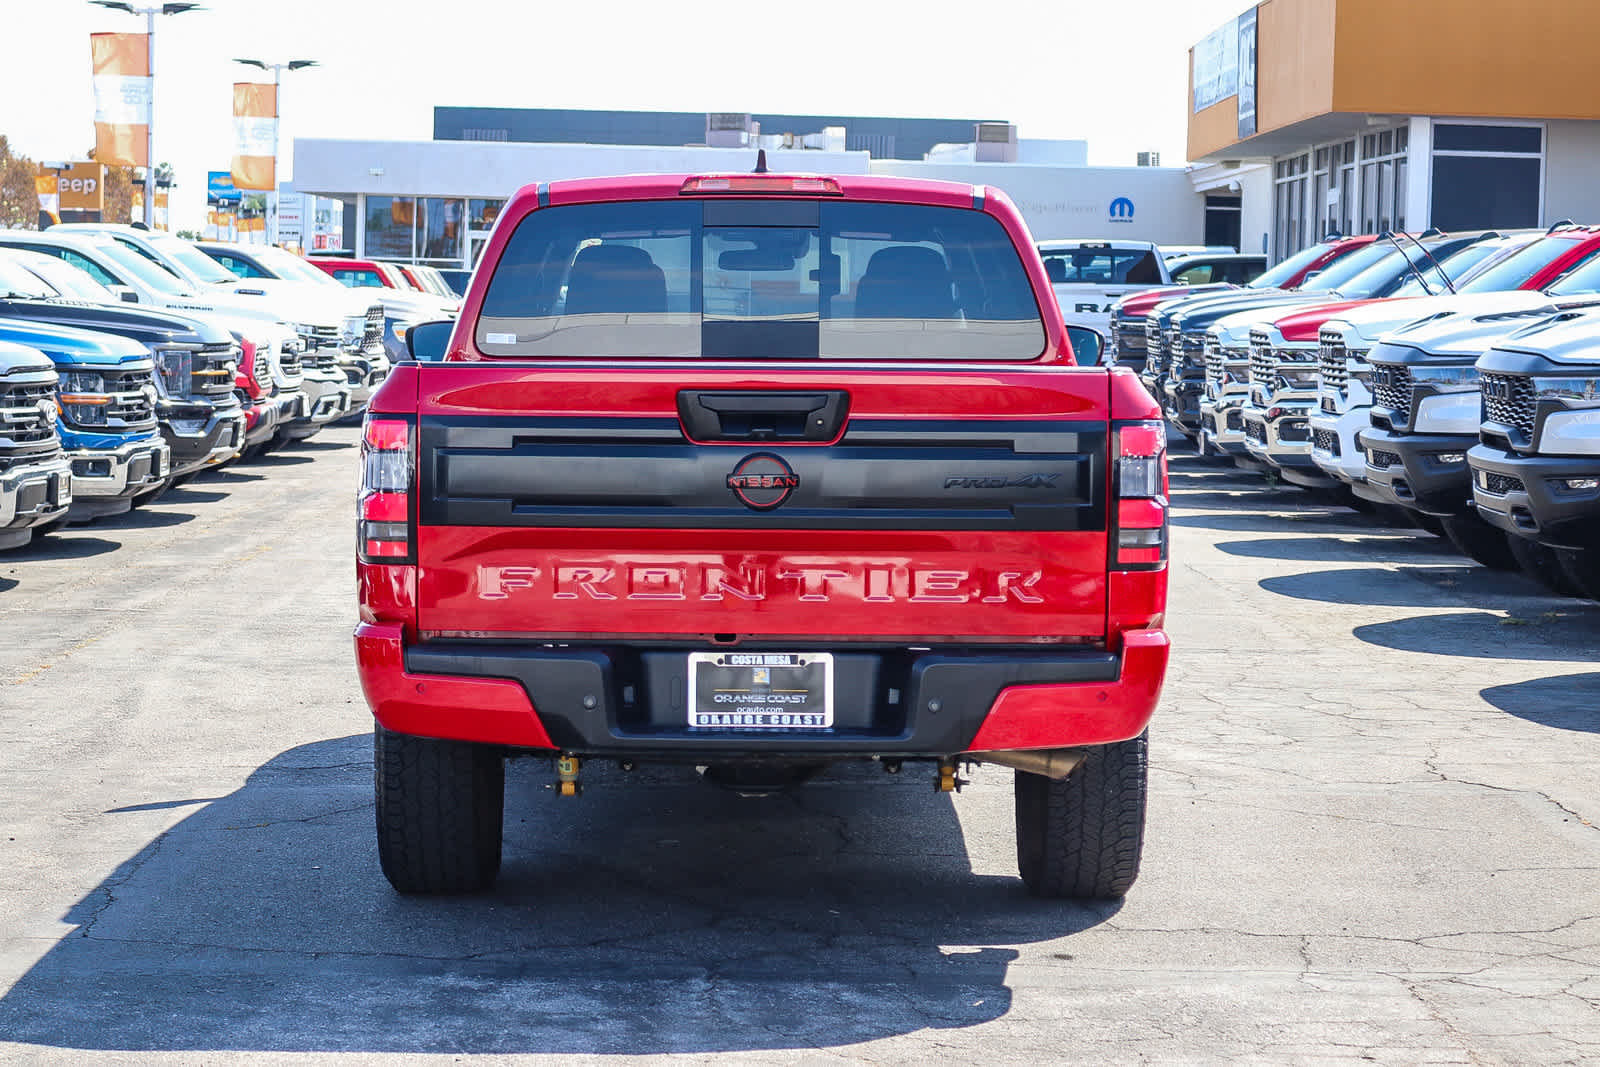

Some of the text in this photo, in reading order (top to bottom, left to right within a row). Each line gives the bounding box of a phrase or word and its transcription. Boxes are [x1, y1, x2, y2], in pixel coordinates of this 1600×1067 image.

[60, 178, 97, 195] eep
[728, 477, 798, 488] NISSAN
[944, 473, 1063, 489] PRO-4X
[476, 562, 1044, 604] FRONTIER
[731, 654, 792, 665] COSTA MESA
[713, 694, 808, 704] ORANGE COAST
[736, 705, 784, 714] ocauto.com
[700, 714, 824, 726] ORANGE COAST
